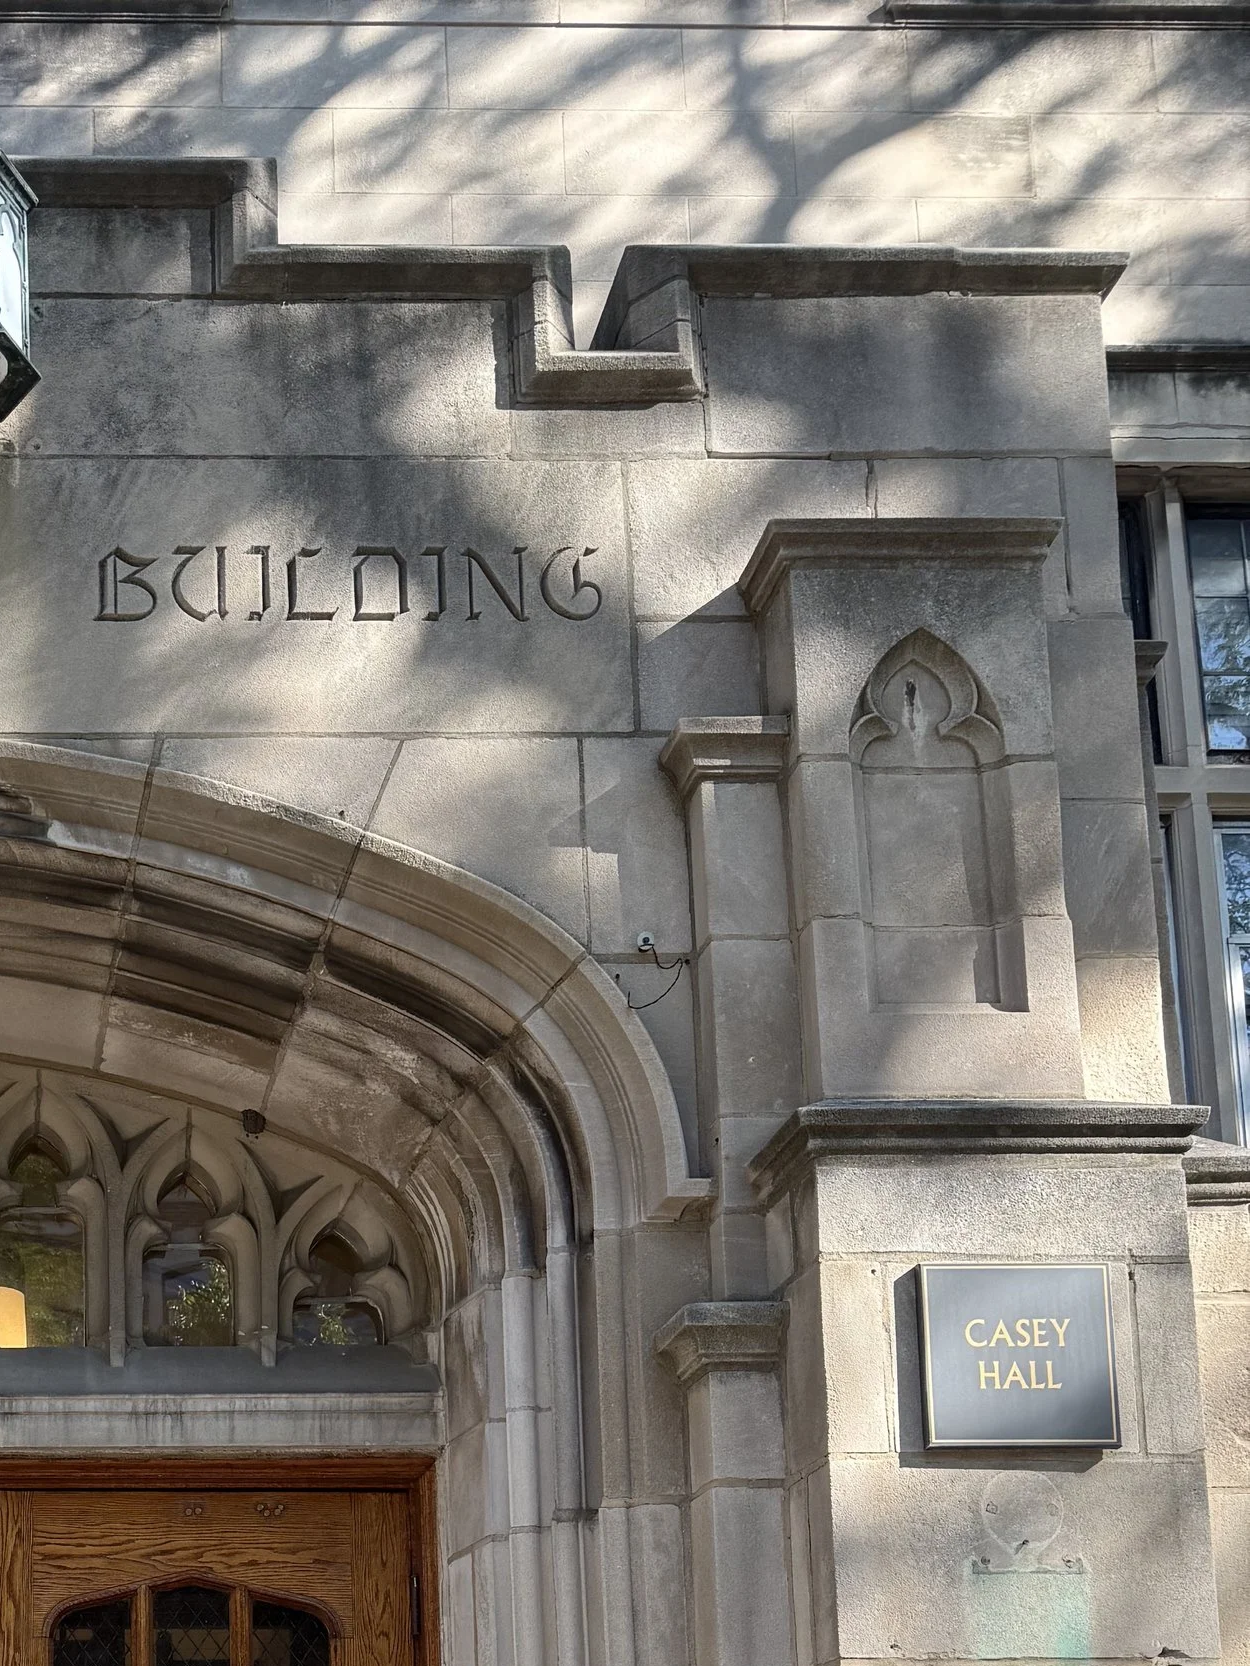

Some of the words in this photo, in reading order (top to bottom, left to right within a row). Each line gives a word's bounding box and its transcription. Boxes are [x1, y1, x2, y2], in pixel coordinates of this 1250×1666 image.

[92, 543, 604, 624] BUILDING
[965, 1317, 1071, 1348] CASEY
[978, 1360, 1063, 1390] HALL
